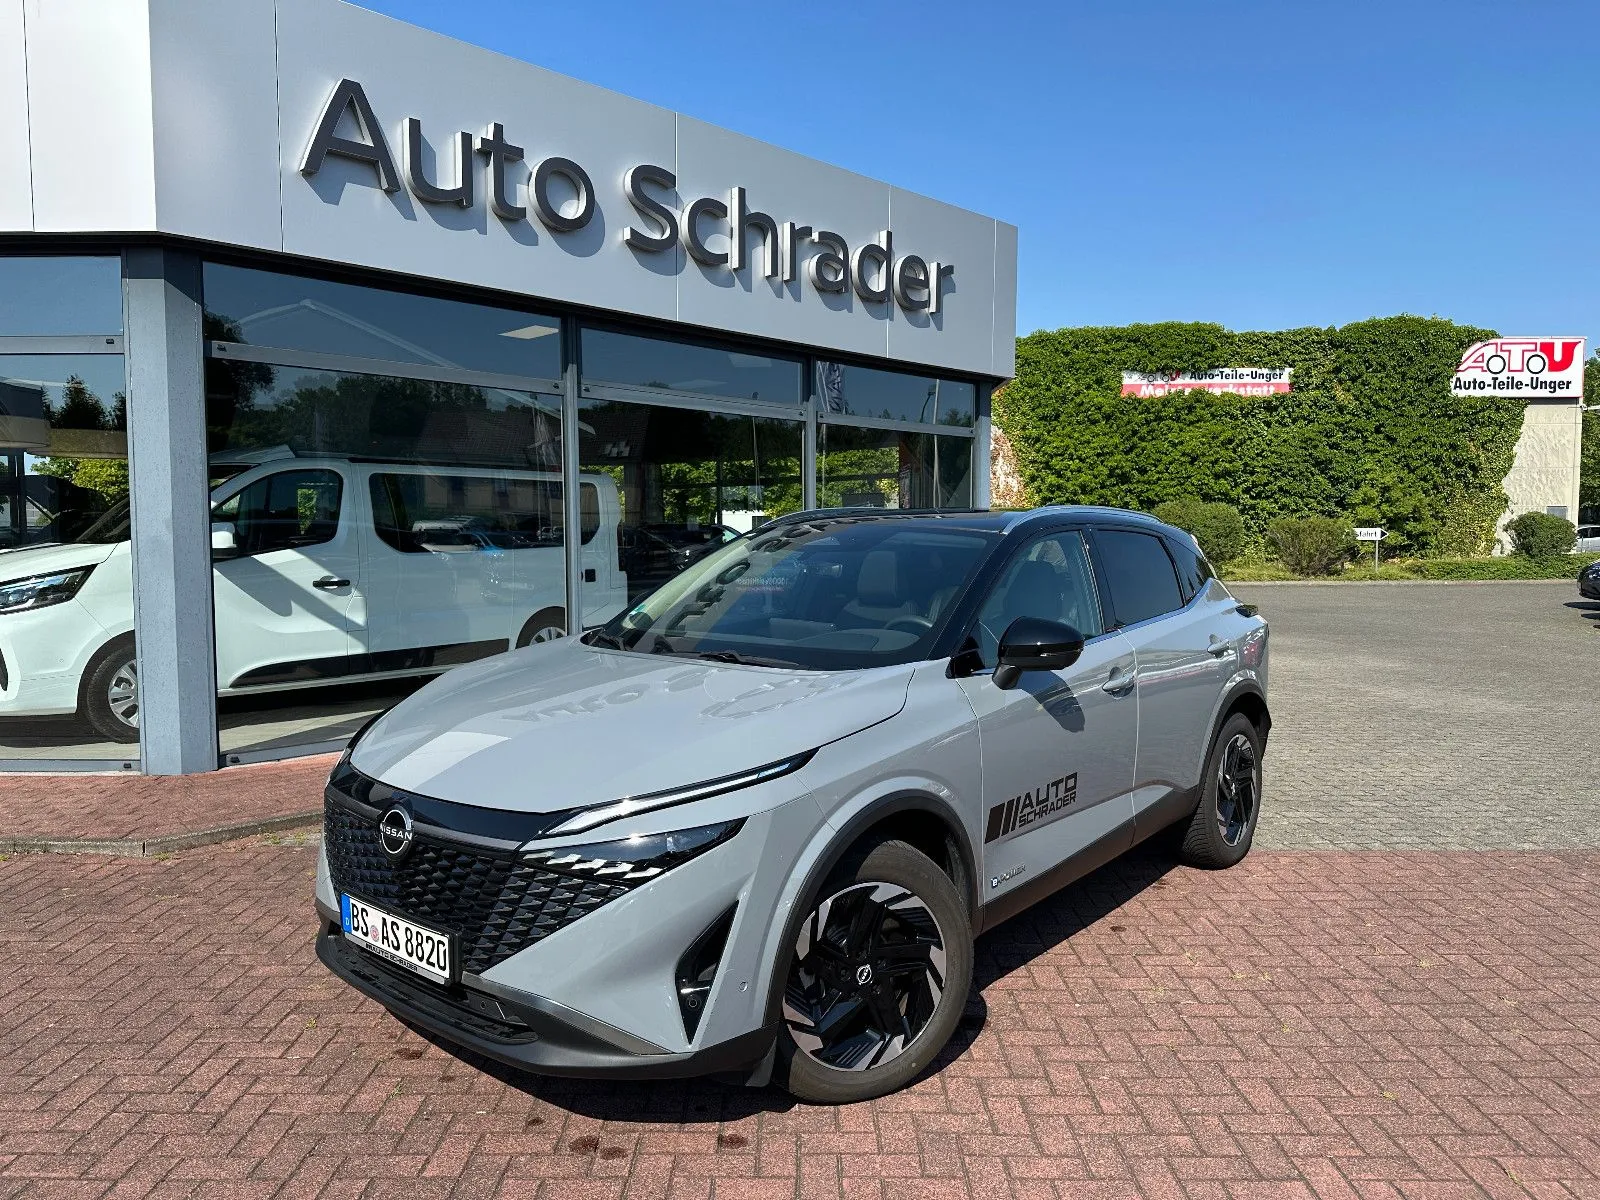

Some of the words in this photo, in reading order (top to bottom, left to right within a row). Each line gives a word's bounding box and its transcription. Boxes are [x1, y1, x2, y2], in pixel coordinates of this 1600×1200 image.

[300, 78, 595, 232] Auto
[622, 163, 955, 314] Schrader
[1189, 370, 1284, 382] Auto-Teile-Unger
[1453, 376, 1572, 393] Auto-Teile-Unger
[1018, 791, 1077, 828] SCHRADER
[1020, 772, 1078, 814] AUTO
[379, 822, 413, 840] NISSAN
[351, 902, 369, 937] BS
[381, 916, 401, 952] AS
[404, 926, 447, 972] 8820
